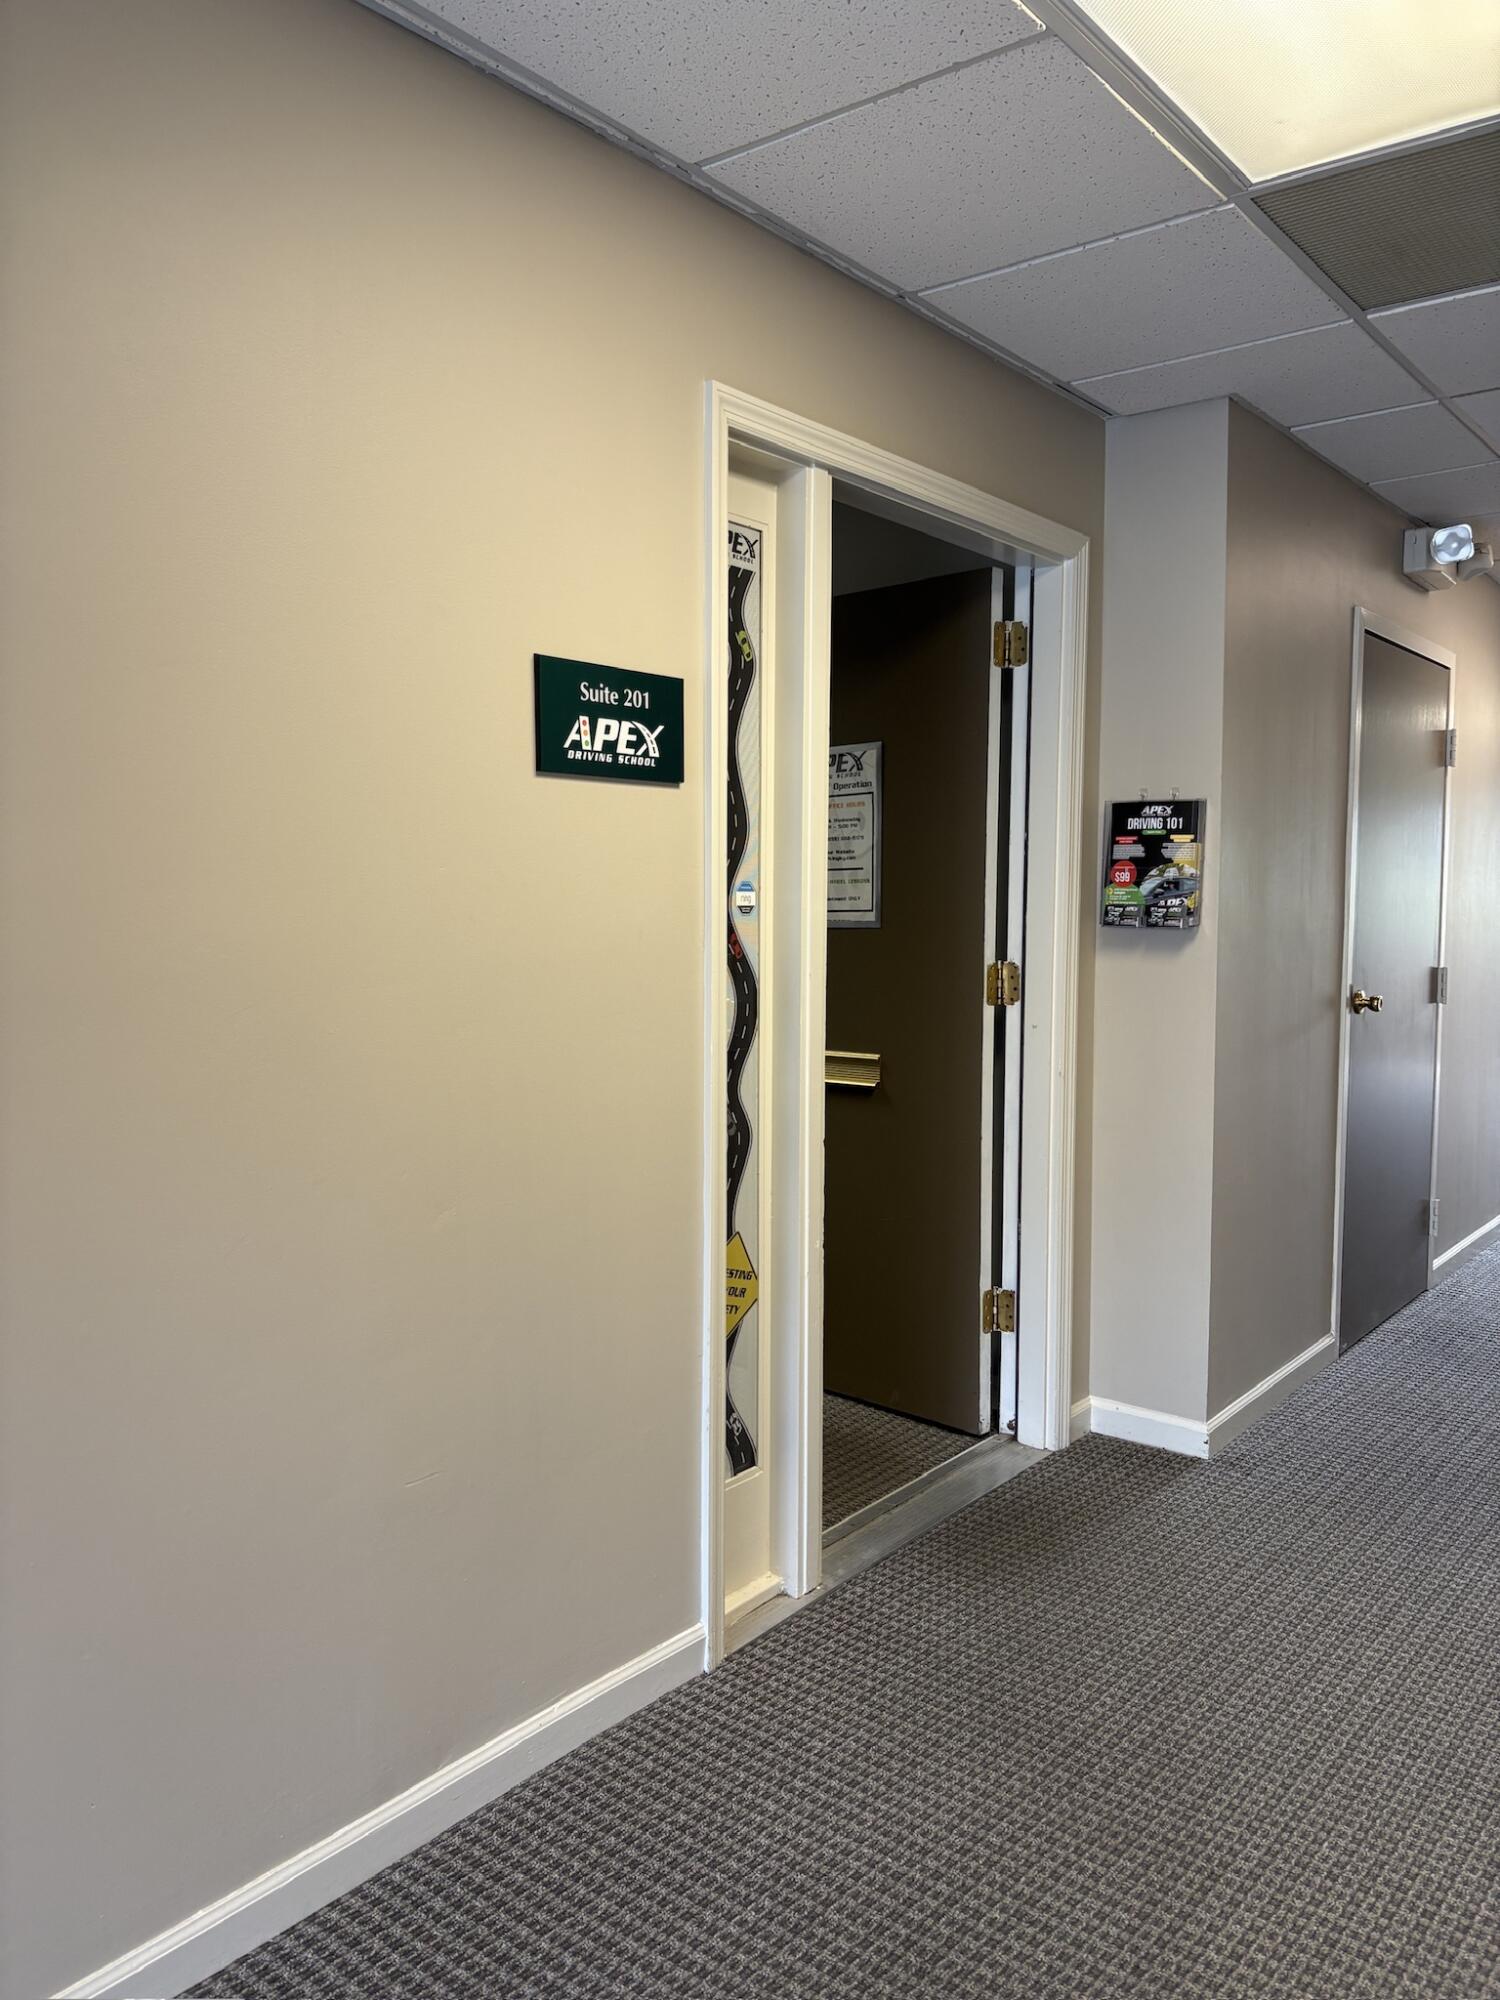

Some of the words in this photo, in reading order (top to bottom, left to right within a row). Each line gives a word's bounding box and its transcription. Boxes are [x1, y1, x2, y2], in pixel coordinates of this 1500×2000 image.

[580, 681, 619, 705] Suite
[623, 688, 650, 709] 201
[563, 715, 665, 758] APEX
[567, 750, 613, 763] DRIVING
[618, 755, 657, 767] SCHOOL
[833, 781, 873, 791] Operation
[1141, 805, 1174, 816] APEX
[1127, 817, 1164, 830] DRIVING
[1166, 817, 1184, 830] 101
[1114, 871, 1131, 883] $99
[727, 1286, 746, 1298] OUR
